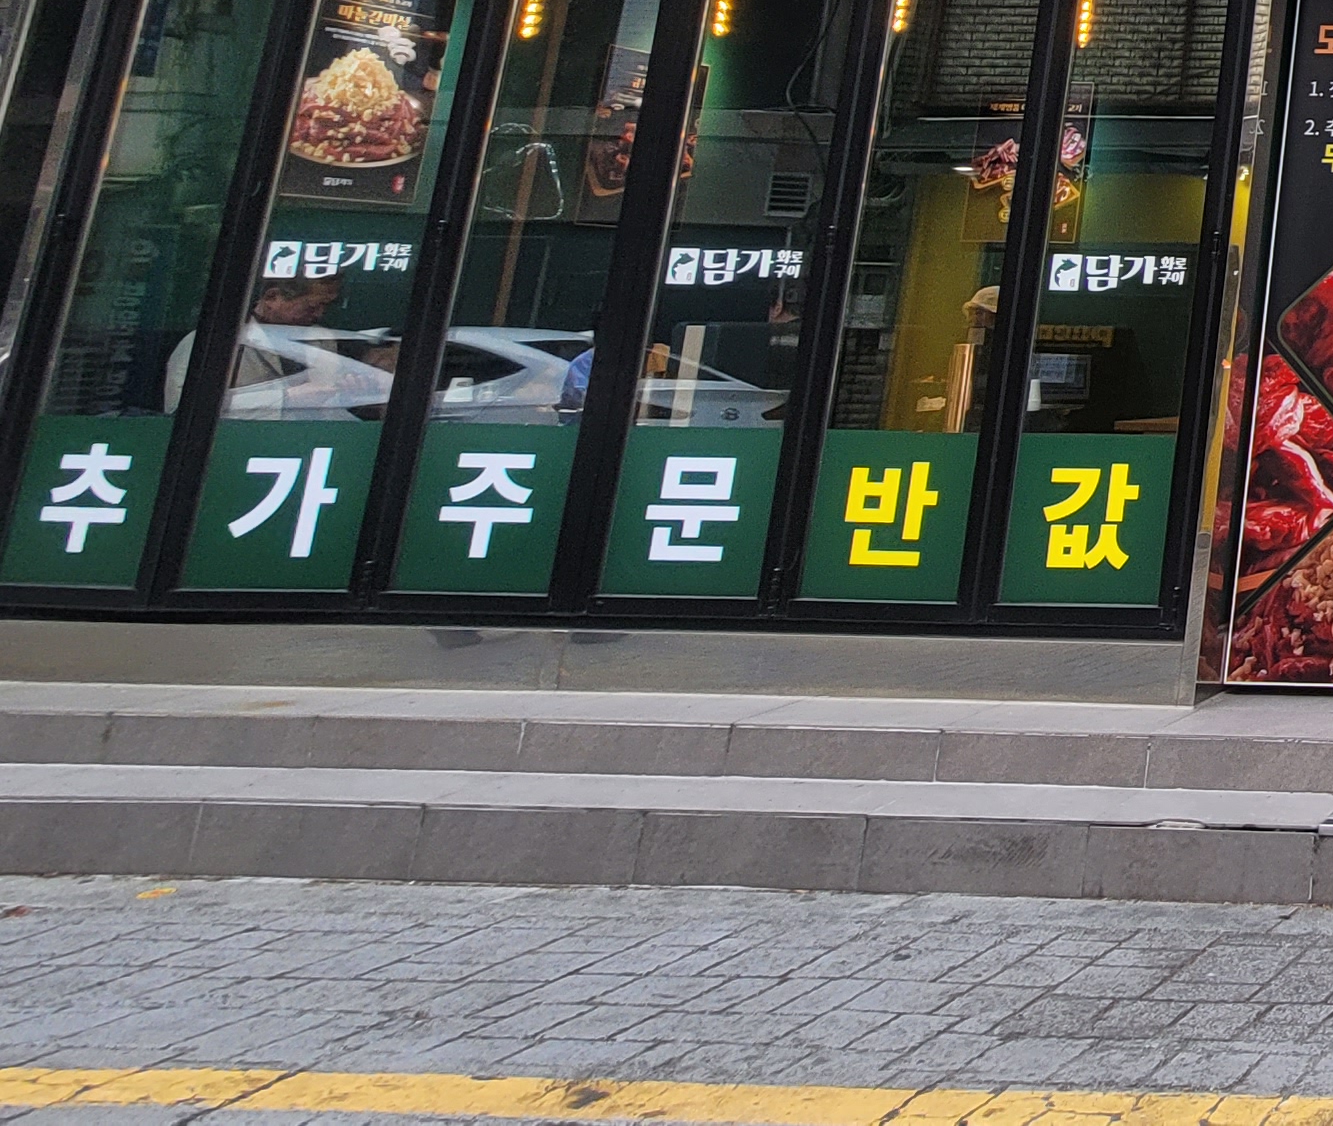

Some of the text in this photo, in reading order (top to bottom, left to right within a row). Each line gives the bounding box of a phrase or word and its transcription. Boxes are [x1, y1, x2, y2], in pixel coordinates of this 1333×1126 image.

[303, 240, 413, 279] 담가 화로
[380, 256, 410, 272] 구이
[701, 248, 803, 286] 담가 화로
[773, 263, 801, 279] 구이
[1085, 254, 1188, 292] 담가 화로
[1157, 270, 1186, 286] 구이
